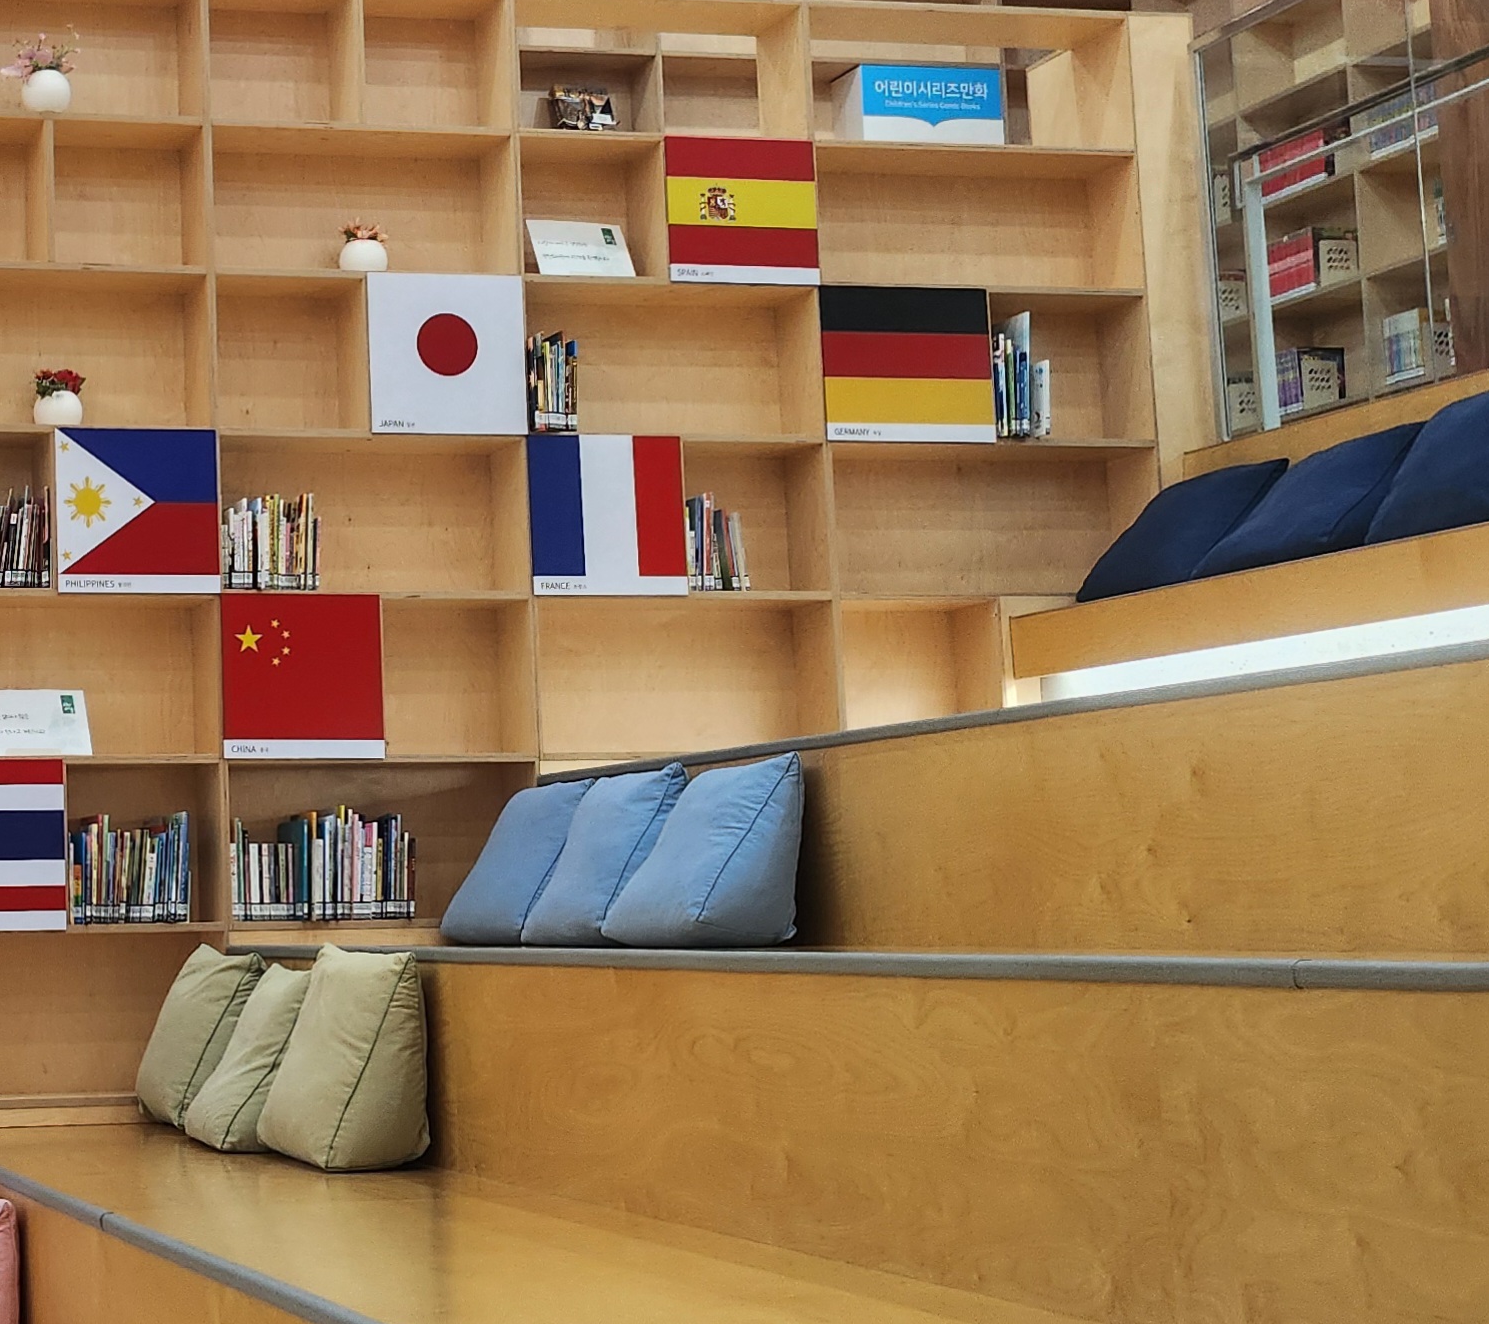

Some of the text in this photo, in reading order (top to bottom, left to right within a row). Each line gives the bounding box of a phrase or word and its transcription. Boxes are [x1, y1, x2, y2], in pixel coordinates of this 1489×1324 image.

[874, 80, 988, 100] 어린이시리즈만화
[379, 419, 405, 428] JAPAN
[834, 427, 870, 436] GERMANY
[65, 579, 115, 588] PHILIPPINES
[540, 582, 571, 590] FRANCE
[231, 745, 256, 753] CHINA
